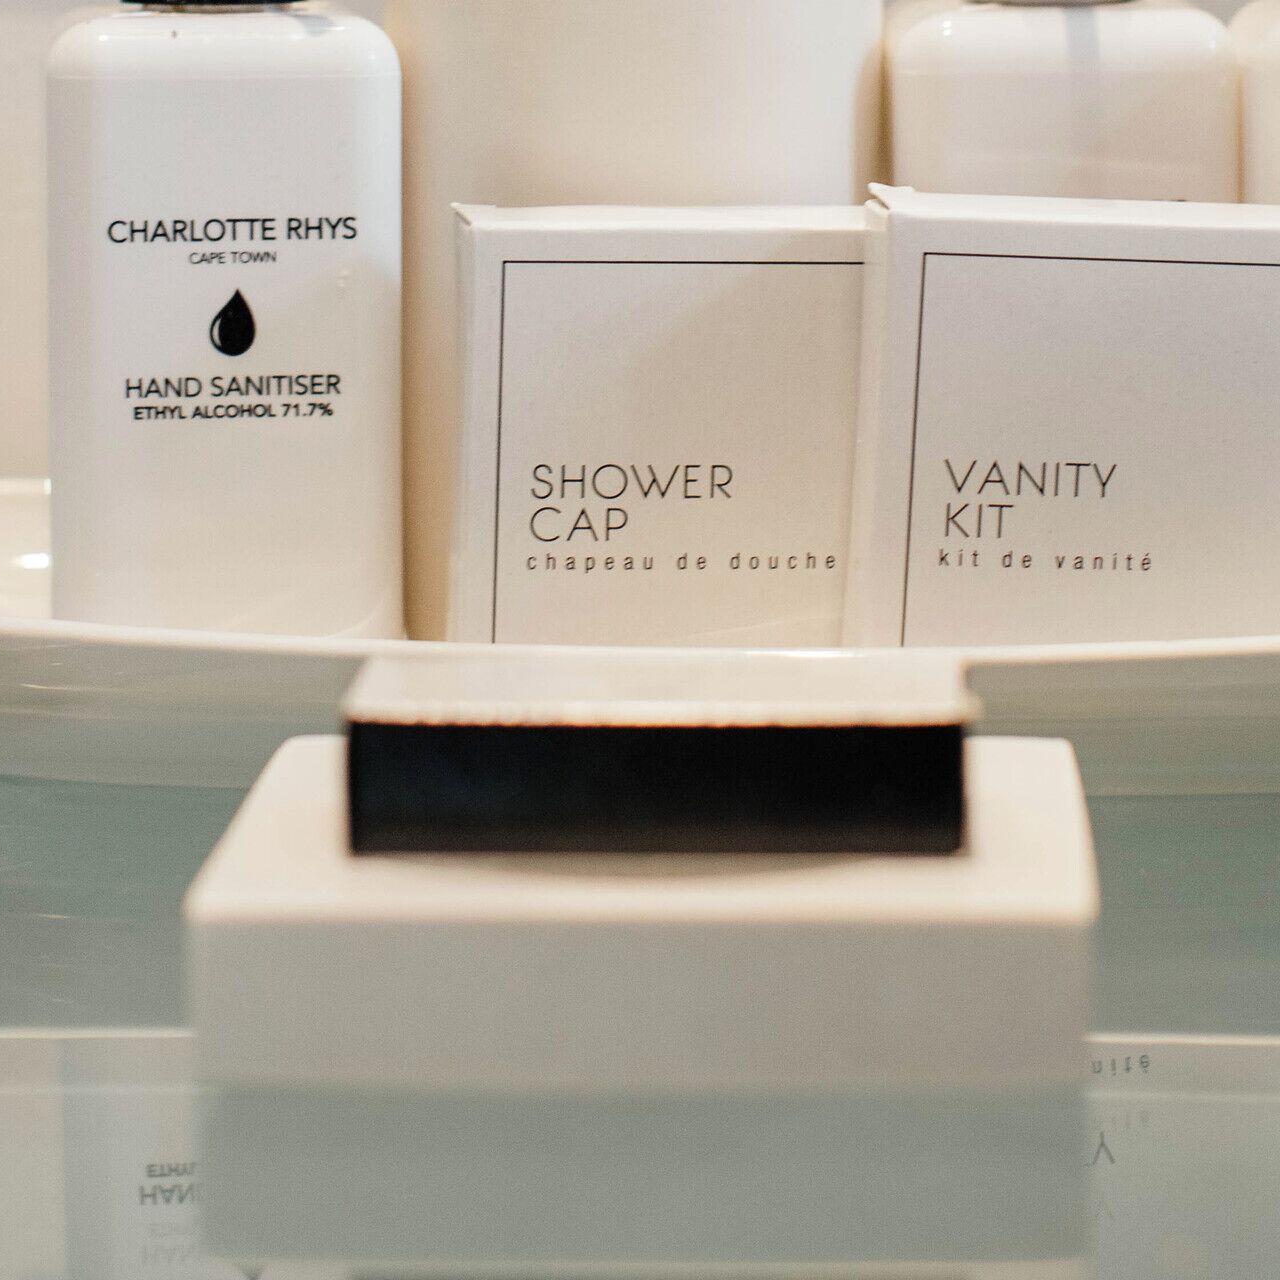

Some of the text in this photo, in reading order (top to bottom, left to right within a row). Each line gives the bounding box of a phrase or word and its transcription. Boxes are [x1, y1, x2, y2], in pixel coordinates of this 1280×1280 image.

[107, 216, 357, 243] CHARLOTTE RHYS
[189, 251, 277, 265] CAPE TOWN
[126, 374, 341, 398] HAND SANITISER
[133, 402, 334, 420] ETHYL ALCOHOL 71.7%
[531, 464, 733, 500] SHOWER
[944, 459, 1117, 498] VANITY
[530, 506, 628, 542] CAP
[945, 503, 1014, 538] KIT
[526, 552, 835, 573] chapeau de douche
[939, 549, 1151, 571] kit de vanité
